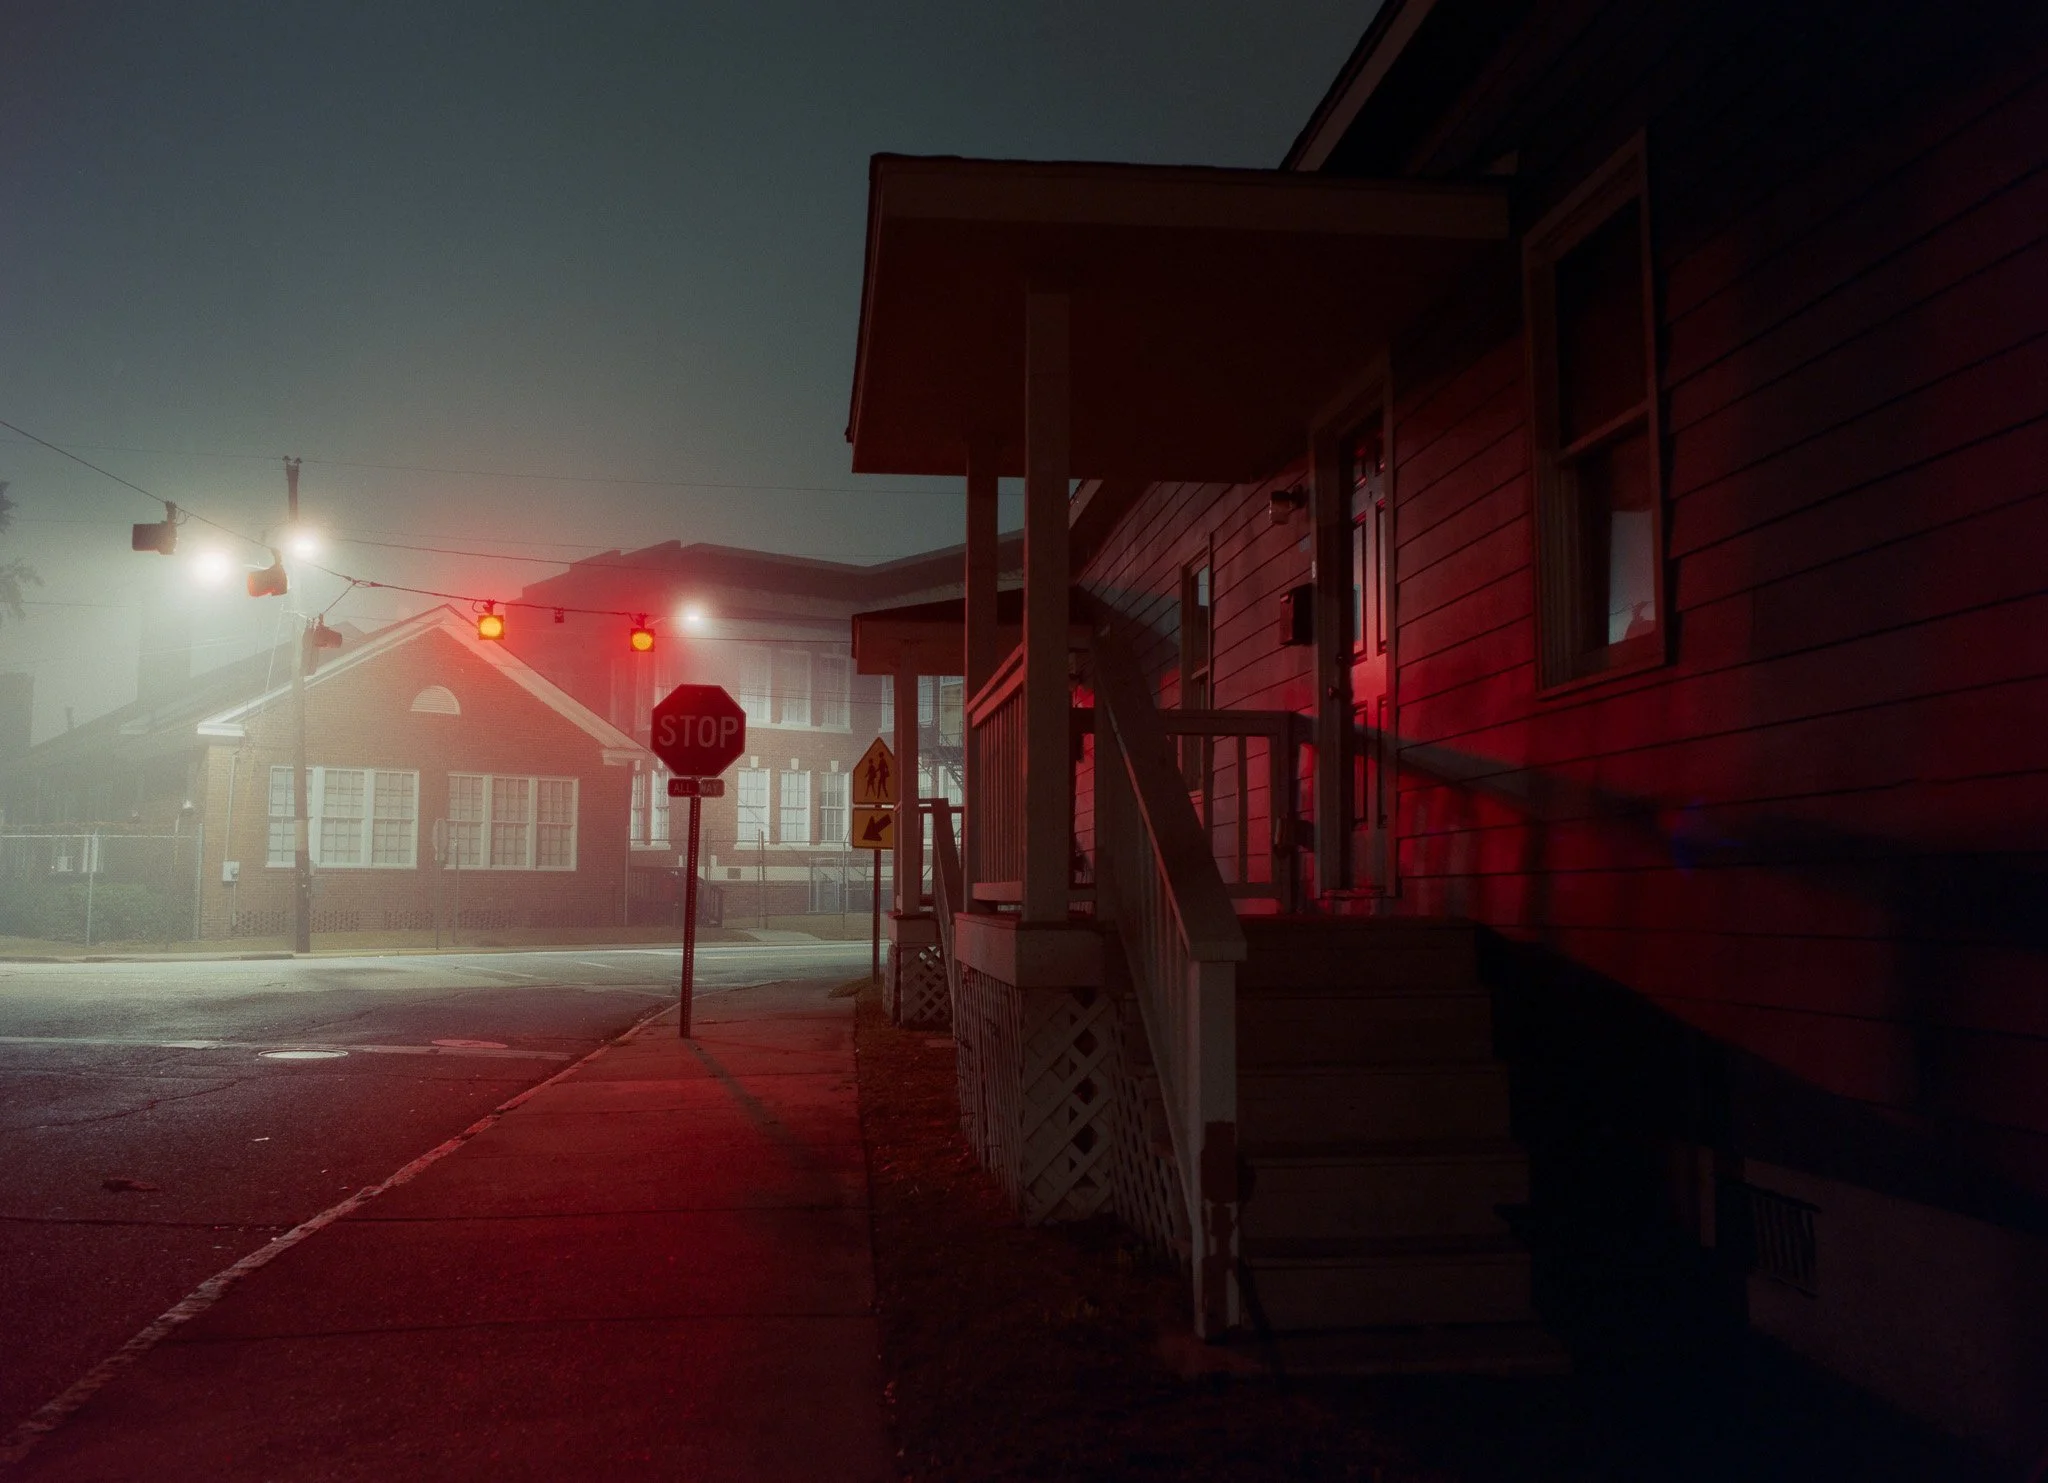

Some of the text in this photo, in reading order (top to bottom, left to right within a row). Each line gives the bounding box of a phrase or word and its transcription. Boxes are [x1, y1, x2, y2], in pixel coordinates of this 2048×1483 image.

[658, 715, 739, 748] STOP
[673, 783, 719, 794] ALL WAY
